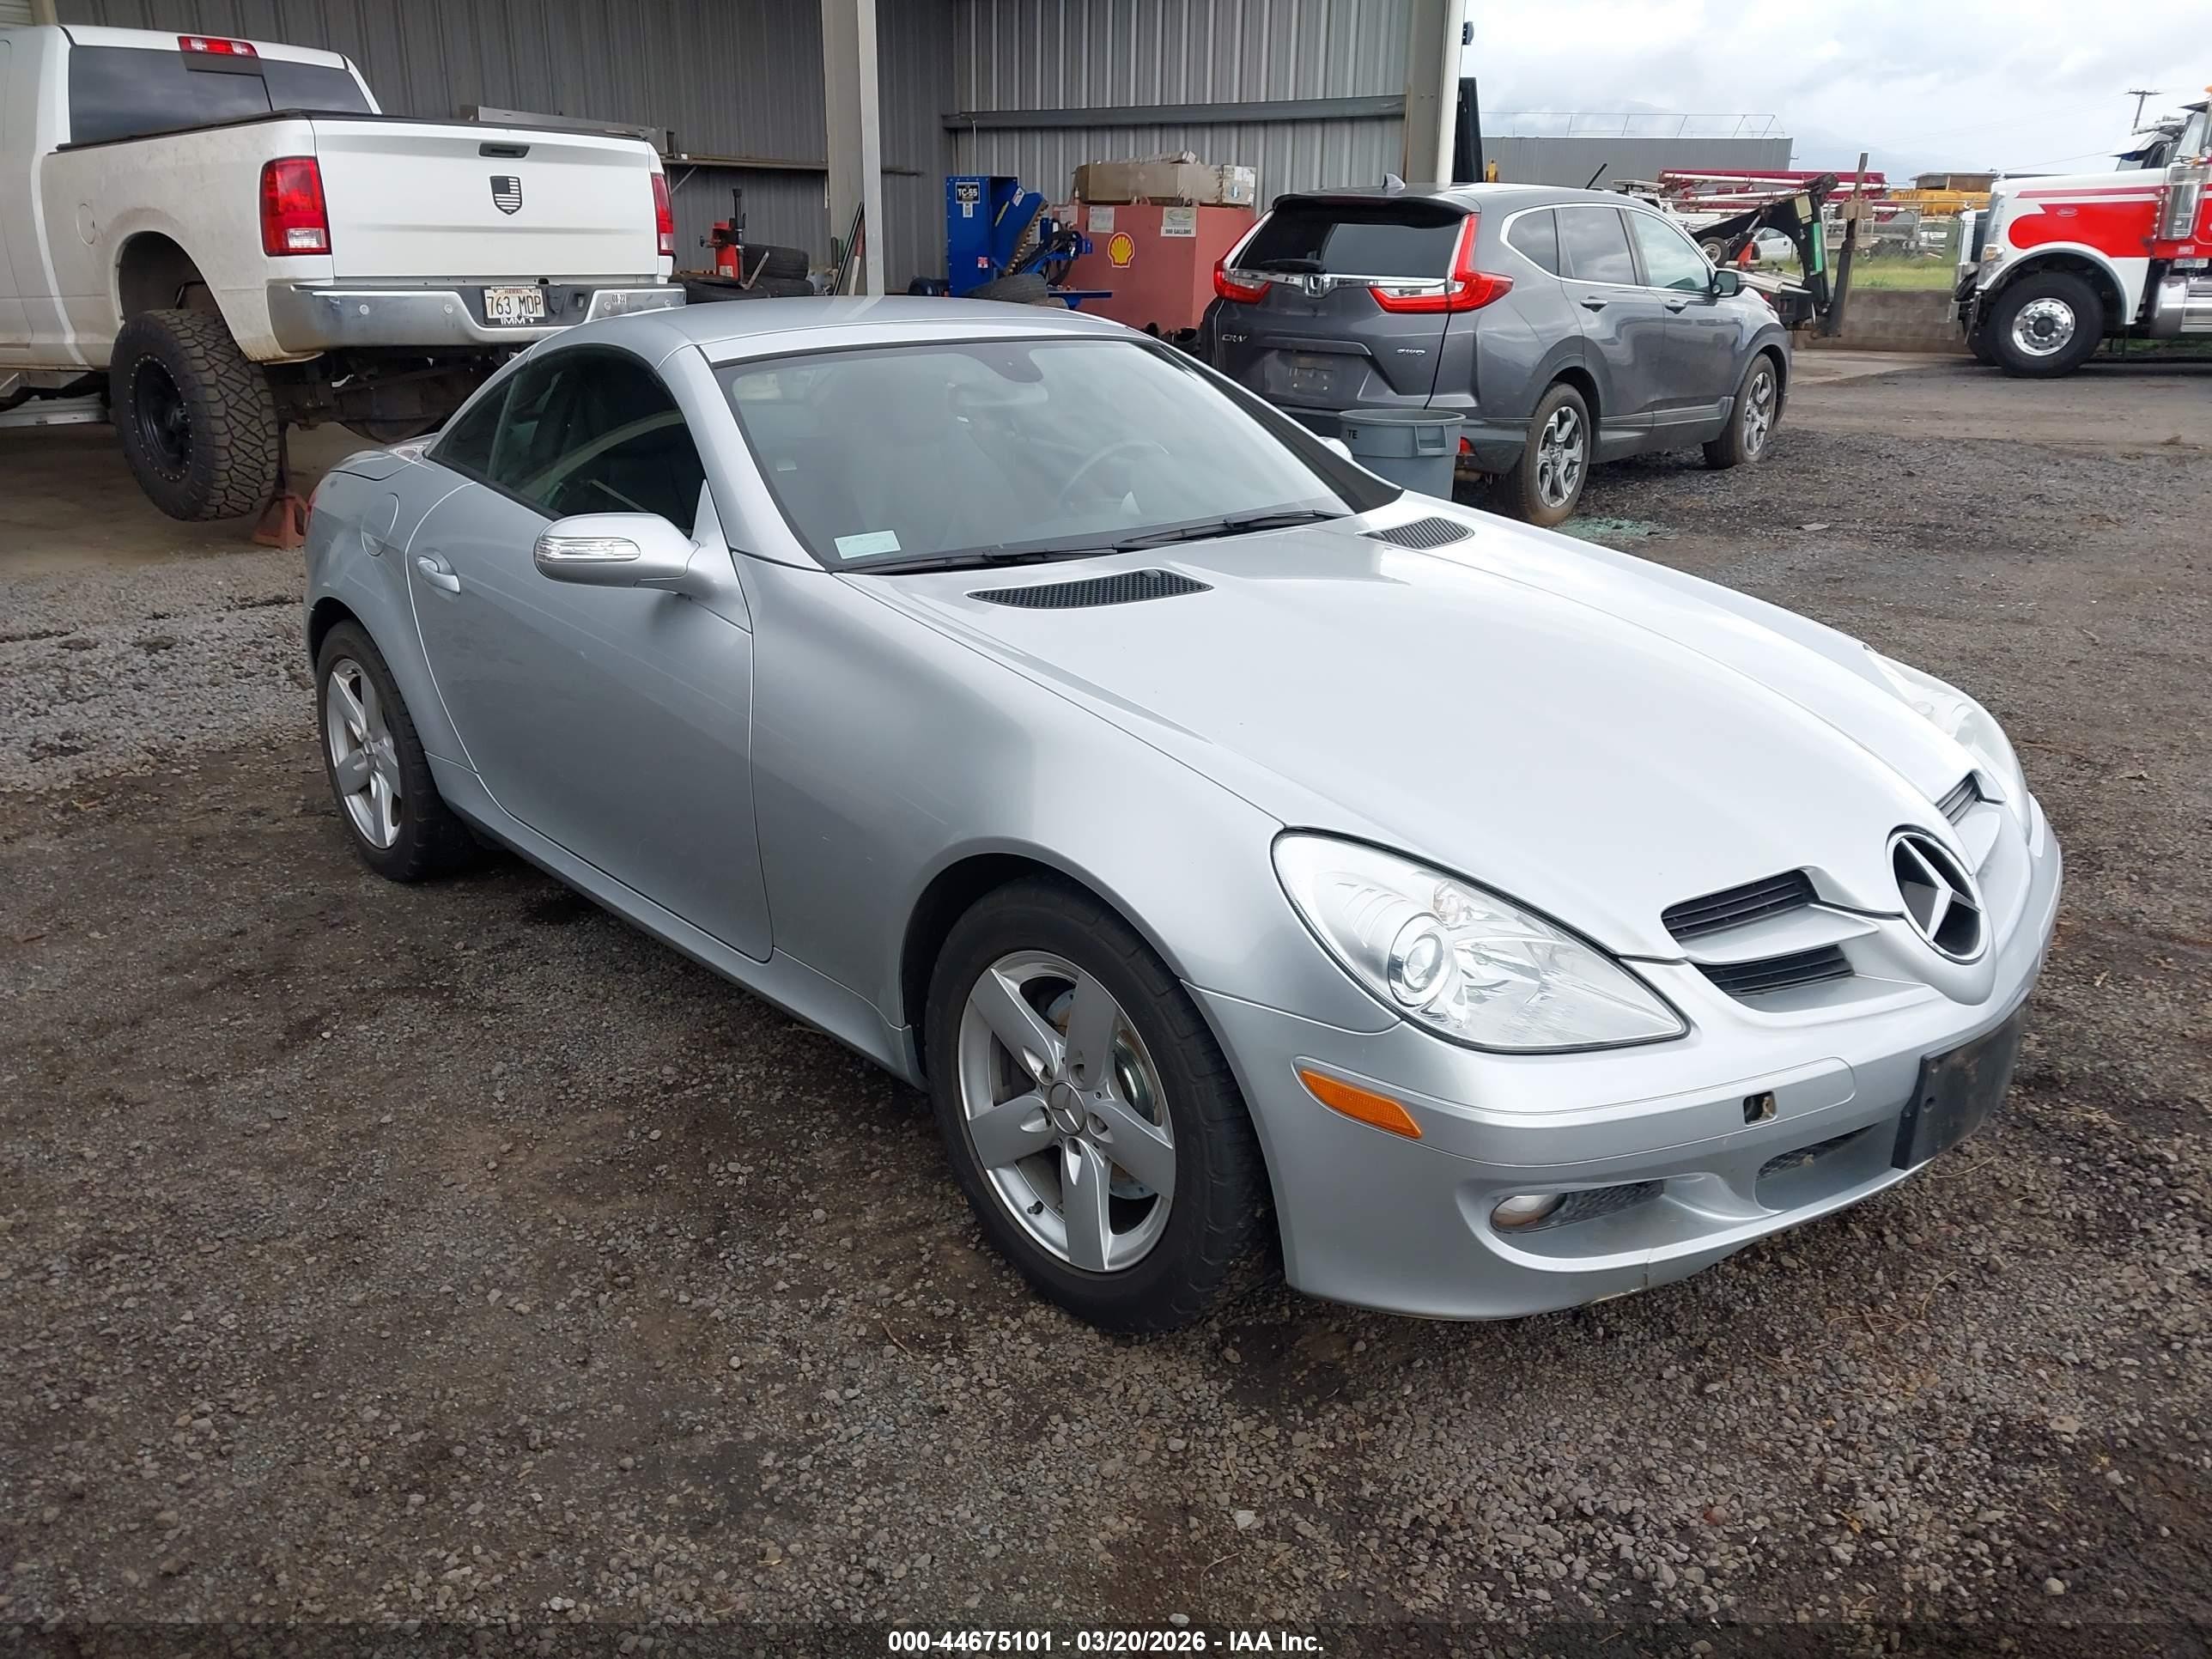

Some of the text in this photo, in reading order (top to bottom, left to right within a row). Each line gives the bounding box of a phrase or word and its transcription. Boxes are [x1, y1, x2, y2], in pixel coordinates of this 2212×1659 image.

[957, 188, 978, 197] TC-55
[486, 295, 542, 316] 763 MDP
[1347, 430, 1358, 439] TE
